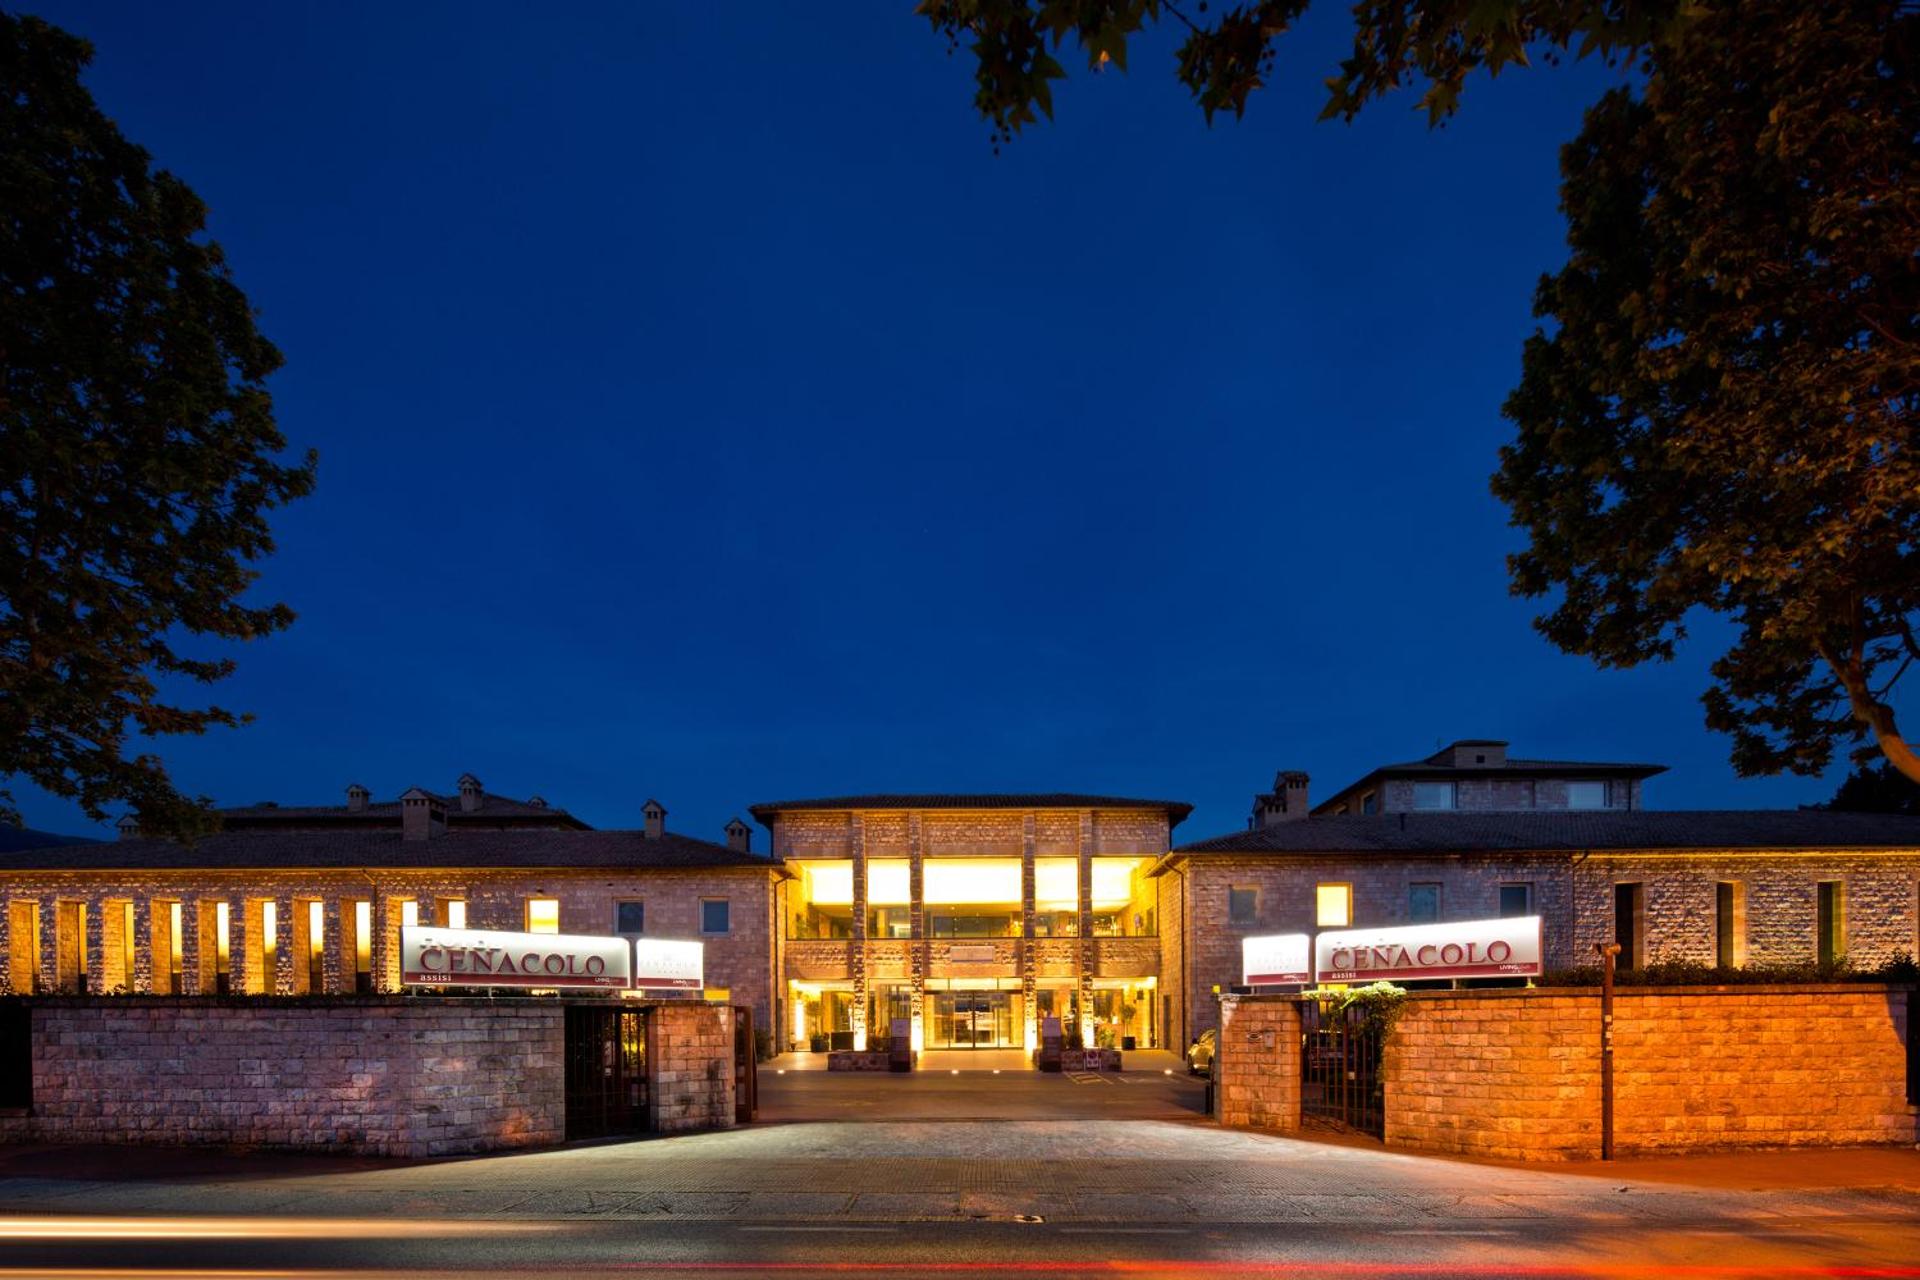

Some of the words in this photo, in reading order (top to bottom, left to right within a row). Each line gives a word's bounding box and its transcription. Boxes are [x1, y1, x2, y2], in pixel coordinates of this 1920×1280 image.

[419, 947, 606, 976] CENACOLO
[1331, 940, 1512, 970] CENACOLO
[420, 973, 452, 982] assisi
